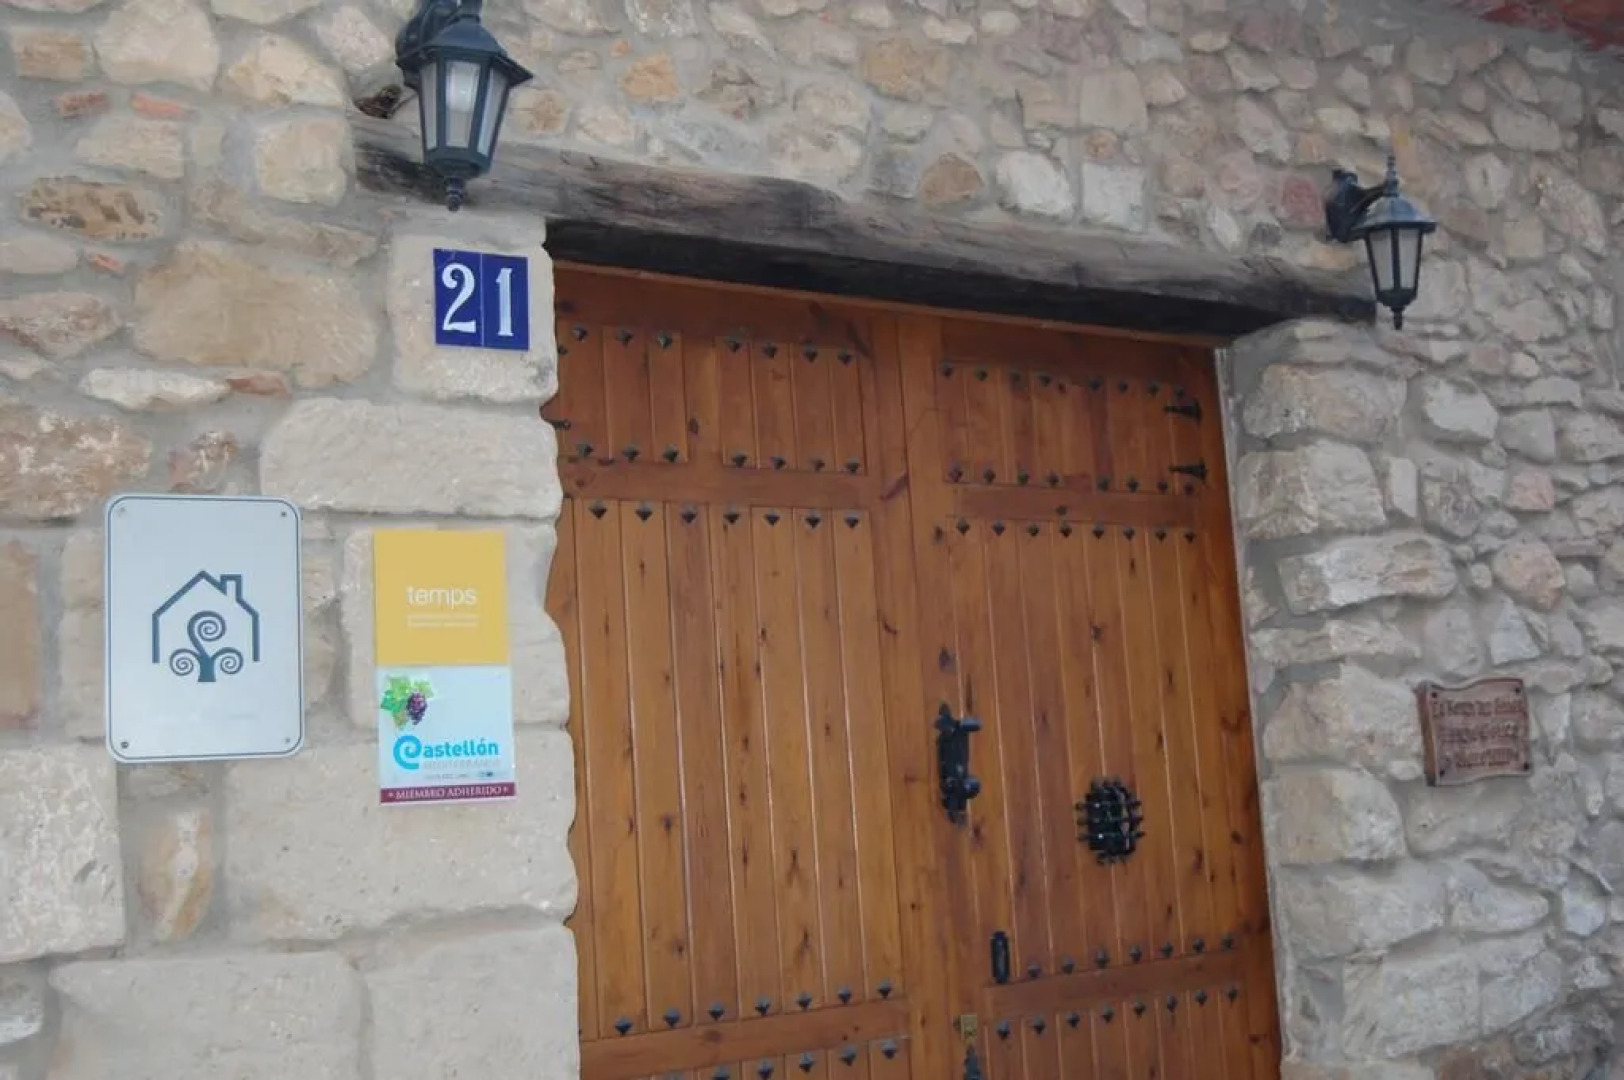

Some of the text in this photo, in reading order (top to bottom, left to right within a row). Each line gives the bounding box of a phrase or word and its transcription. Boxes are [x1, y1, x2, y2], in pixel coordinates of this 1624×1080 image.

[442, 263, 514, 337] 21
[406, 586, 477, 610] temps
[395, 785, 502, 800] MIEMBRO ADHERIDO
